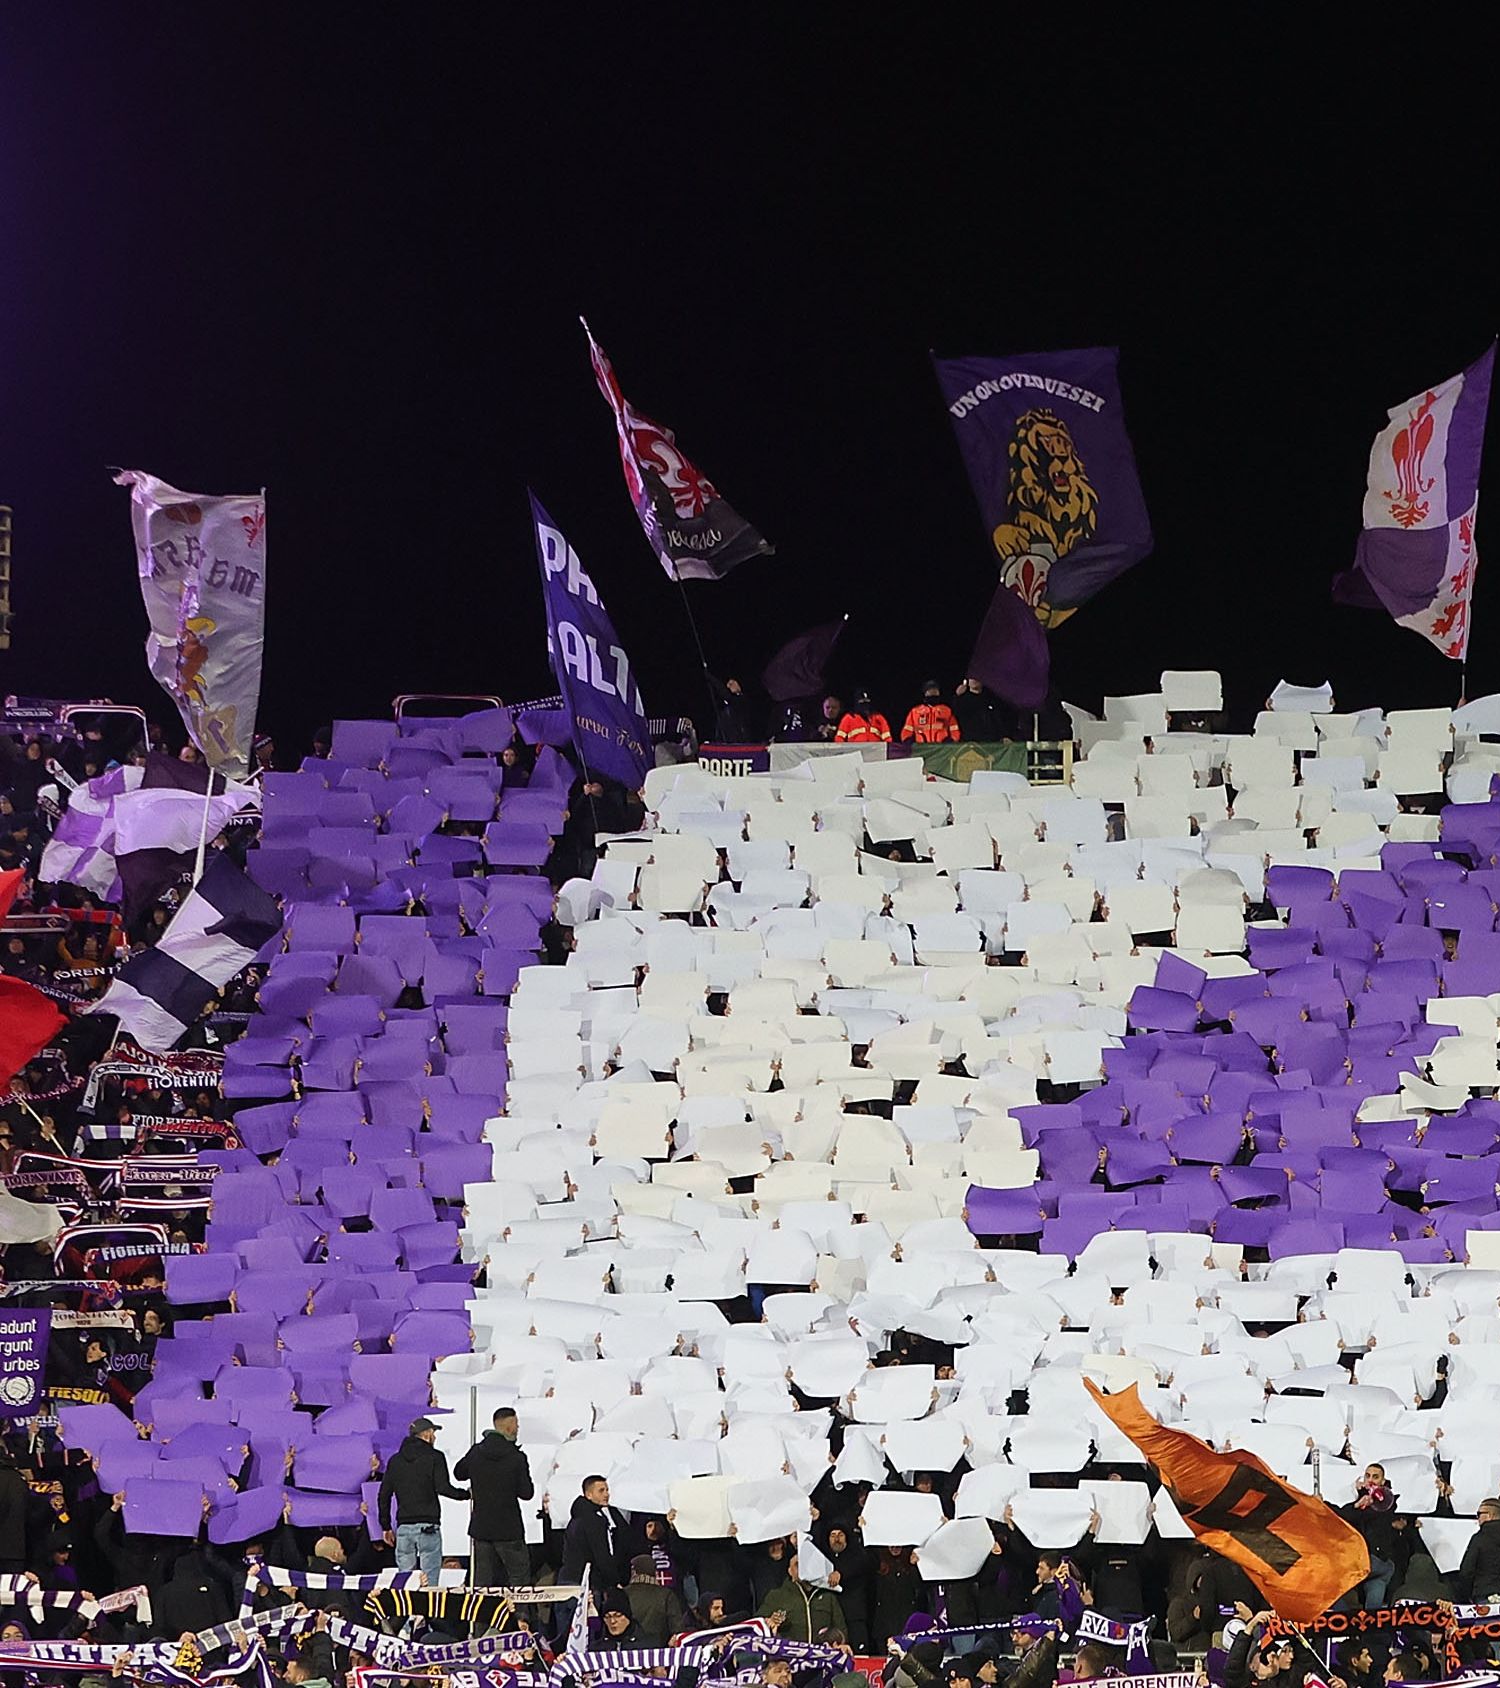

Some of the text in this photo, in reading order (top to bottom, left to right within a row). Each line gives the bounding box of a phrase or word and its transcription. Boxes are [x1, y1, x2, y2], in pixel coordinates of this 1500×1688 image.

[148, 1076, 218, 1090] FIORENTIN
[101, 1242, 191, 1262] FIORENTINA
[0, 1318, 37, 1335] adunt
[4, 1358, 40, 1373] urbes
[1081, 1616, 1109, 1637] RVA
